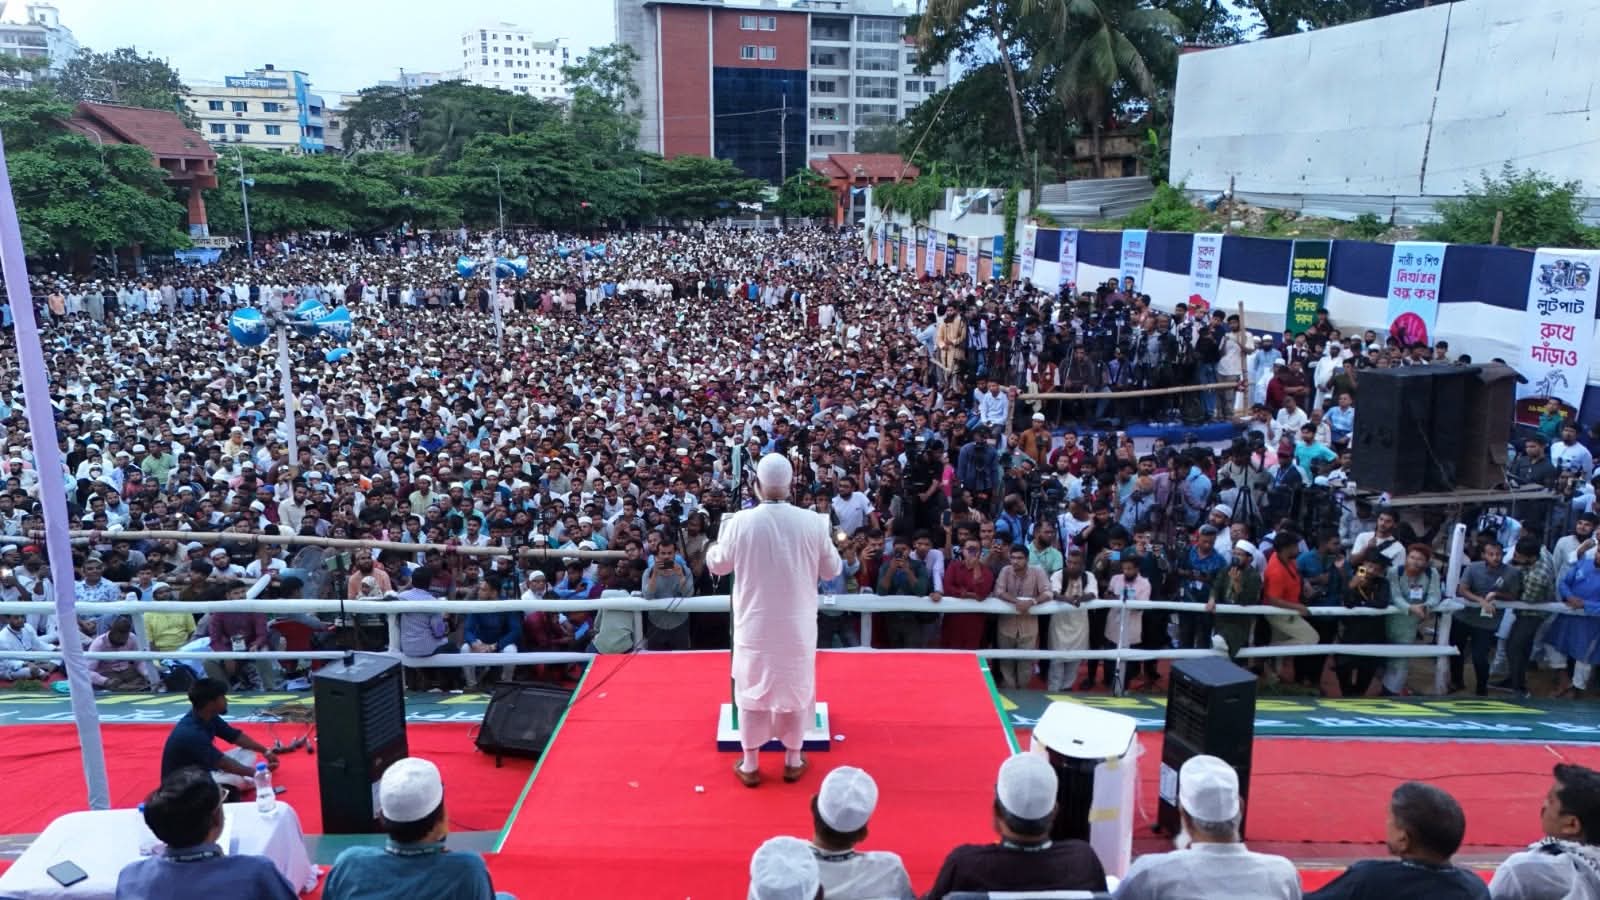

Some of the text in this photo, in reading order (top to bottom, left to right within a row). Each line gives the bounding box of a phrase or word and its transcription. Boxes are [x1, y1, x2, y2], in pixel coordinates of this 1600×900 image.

[1398, 252, 1440, 267] নারী ও শিশু
[1396, 268, 1437, 285] নির্যাতন
[1414, 288, 1436, 301] কর
[1536, 297, 1585, 316] লুটপাট
[1540, 322, 1576, 342] রুখে
[1531, 342, 1578, 368] দাঁড়াও
